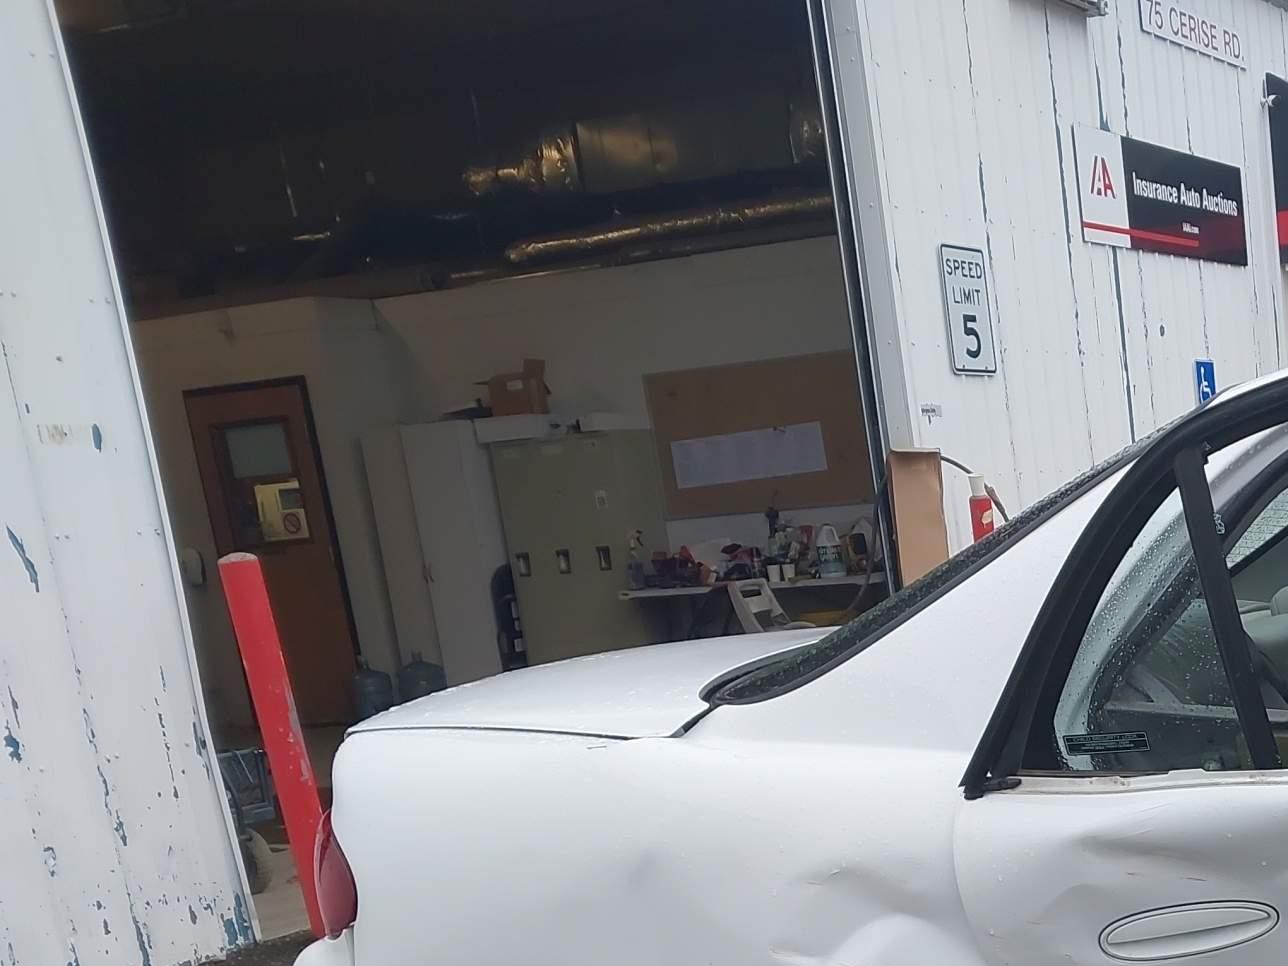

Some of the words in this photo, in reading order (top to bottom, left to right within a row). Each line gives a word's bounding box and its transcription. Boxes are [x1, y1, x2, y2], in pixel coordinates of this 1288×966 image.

[1146, 0, 1163, 30] 75
[1169, 7, 1219, 52] CERISE
[1223, 29, 1245, 62] RD.
[1132, 171, 1178, 203] Insurance
[1180, 182, 1201, 209] Auto
[1202, 188, 1238, 217] Auctions
[945, 258, 983, 279] SPEED
[952, 286, 981, 306] LIMIT
[962, 313, 982, 359] 5
